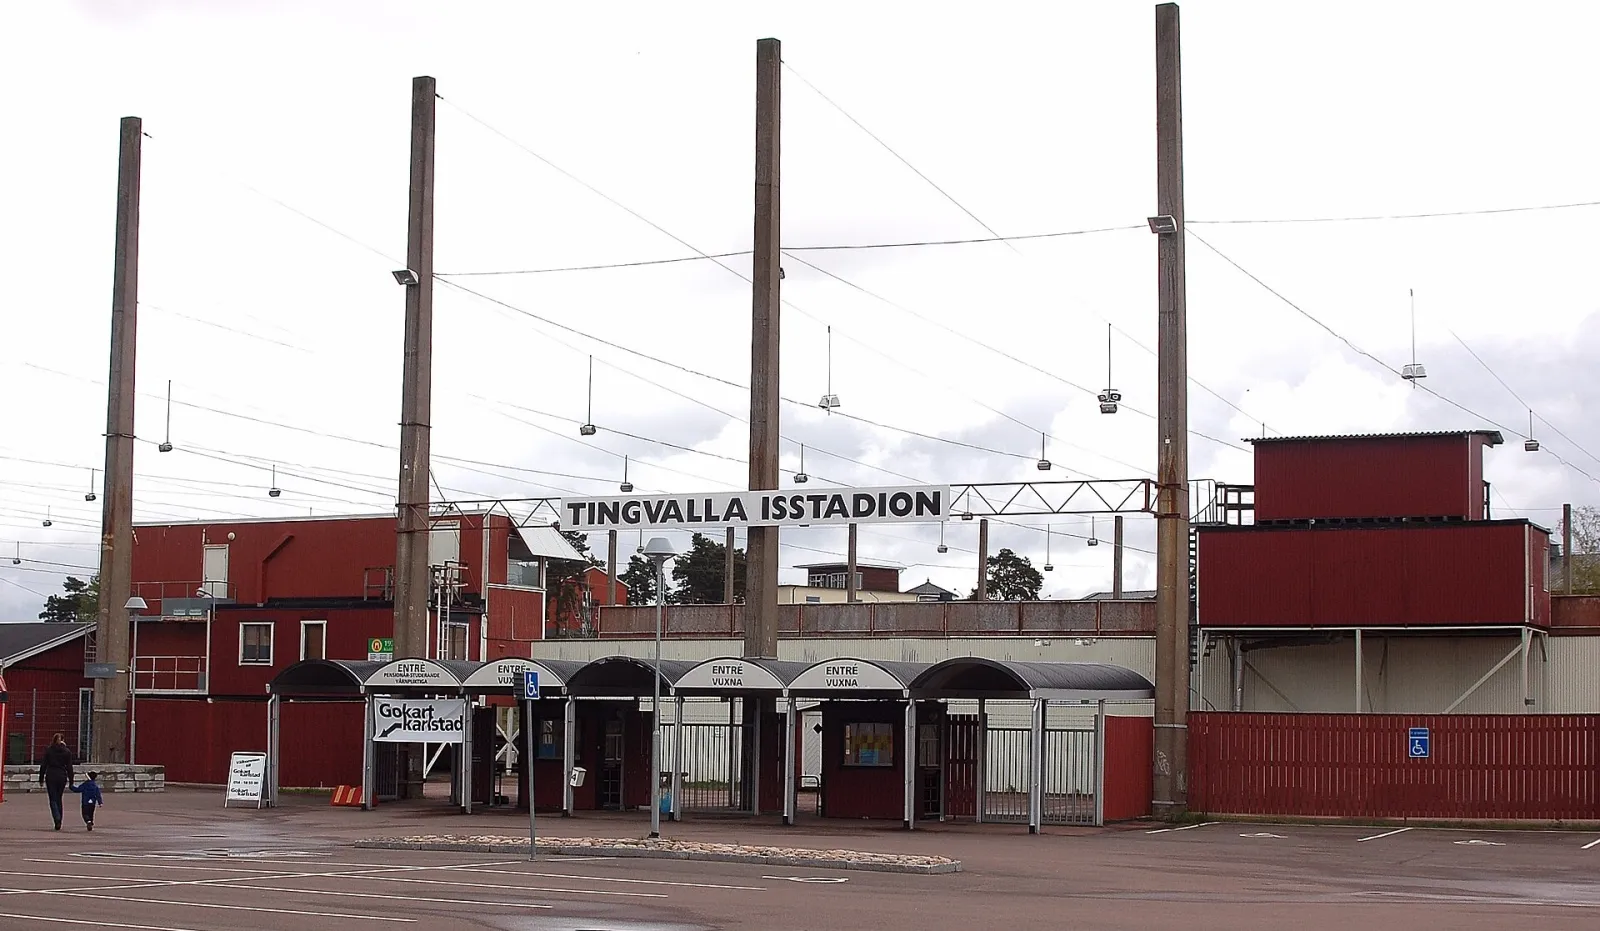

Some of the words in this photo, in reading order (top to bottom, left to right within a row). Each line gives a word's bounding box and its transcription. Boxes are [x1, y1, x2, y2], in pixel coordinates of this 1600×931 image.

[566, 497, 748, 526] TINGVALLA
[761, 491, 941, 520] ISSTADION
[397, 662, 426, 673] ENTRÉ
[712, 663, 743, 675] ENTRÉ
[826, 663, 858, 675] ENTRÉ
[712, 677, 743, 686] VUXNA
[825, 678, 858, 687] VUXNA
[379, 703, 434, 719] Gokart
[402, 714, 463, 731] karlstad
